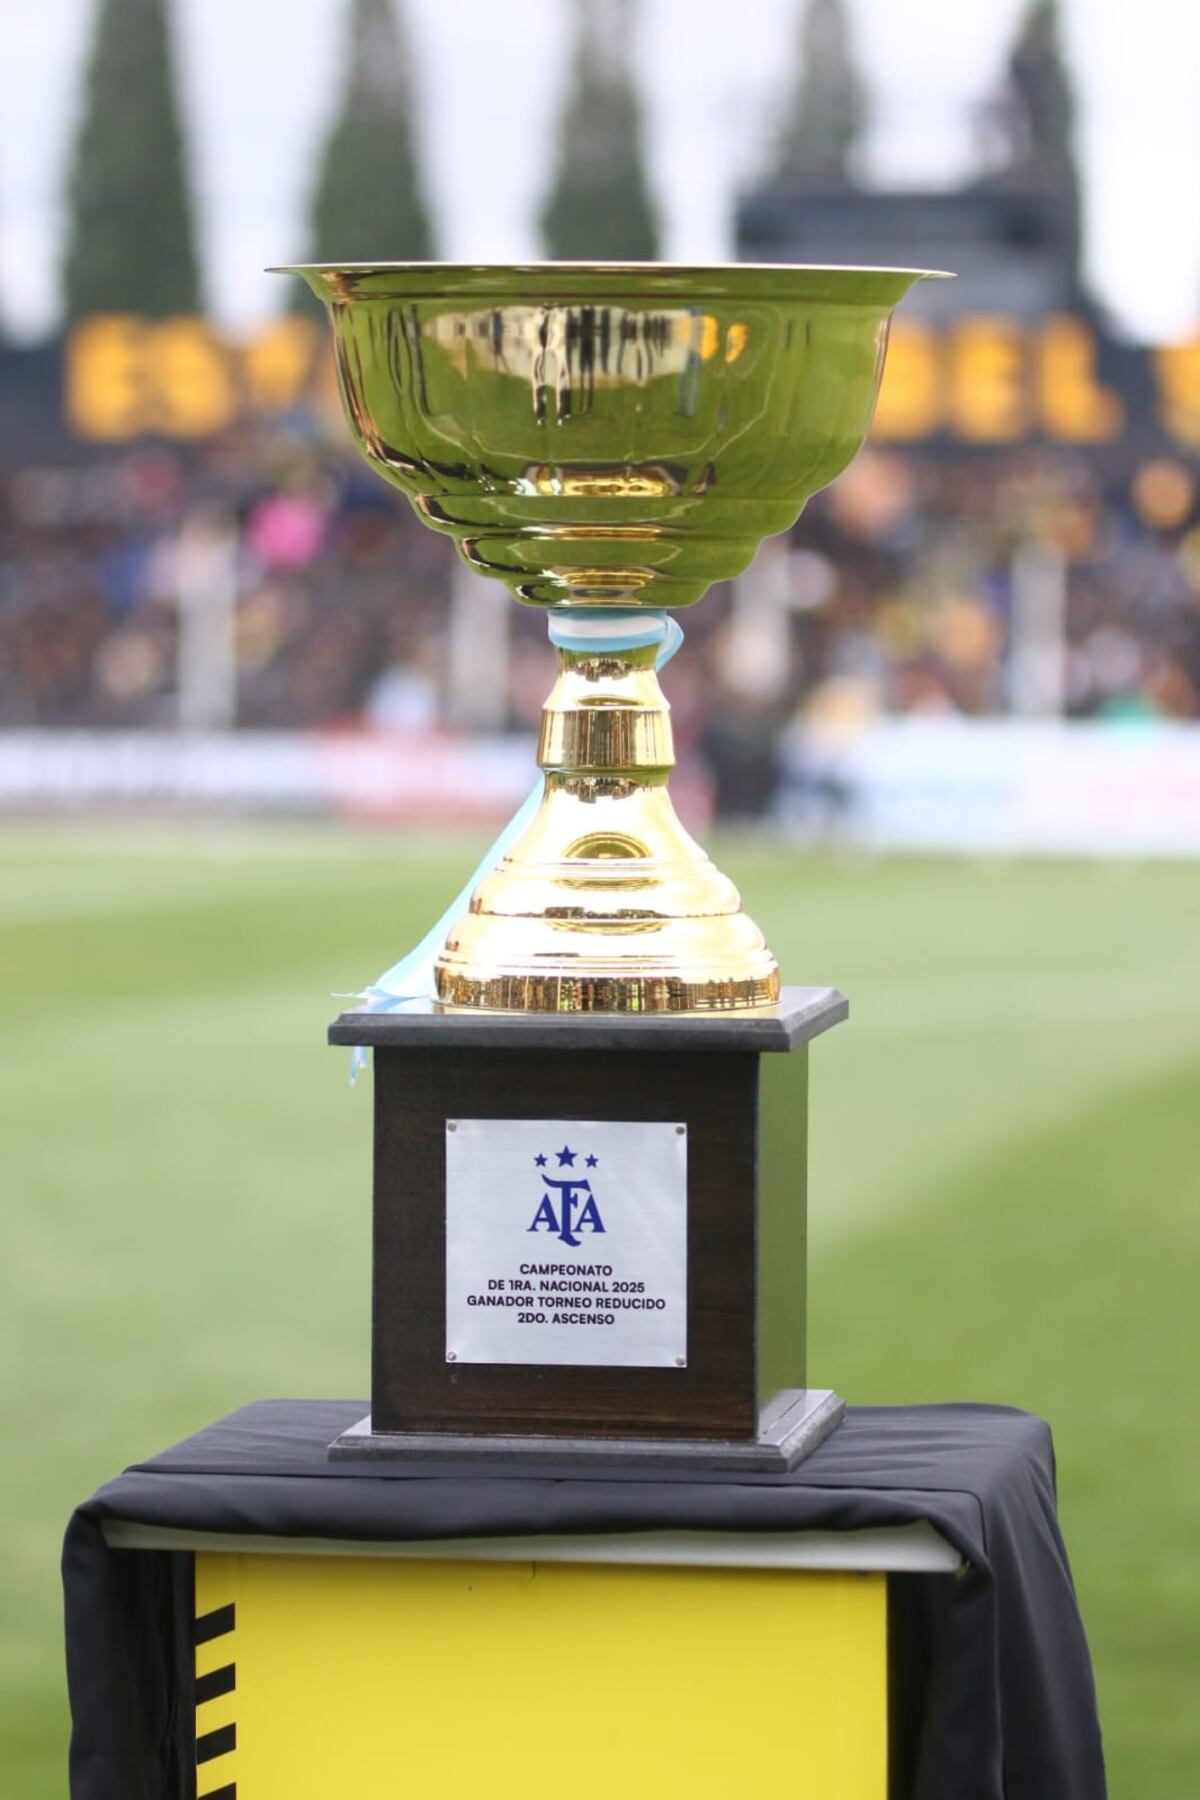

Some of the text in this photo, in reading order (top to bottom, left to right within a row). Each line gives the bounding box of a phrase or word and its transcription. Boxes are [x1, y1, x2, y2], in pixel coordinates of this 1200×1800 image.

[526, 1173, 607, 1248] AFA
[520, 1263, 612, 1276] CAMPEONATO
[488, 1279, 645, 1294] DE 1RA. NACIONAL 2025
[466, 1295, 666, 1310] GANADOR TORNEO REDUCIDO
[517, 1311, 615, 1325] 2DO. ASCENSO
